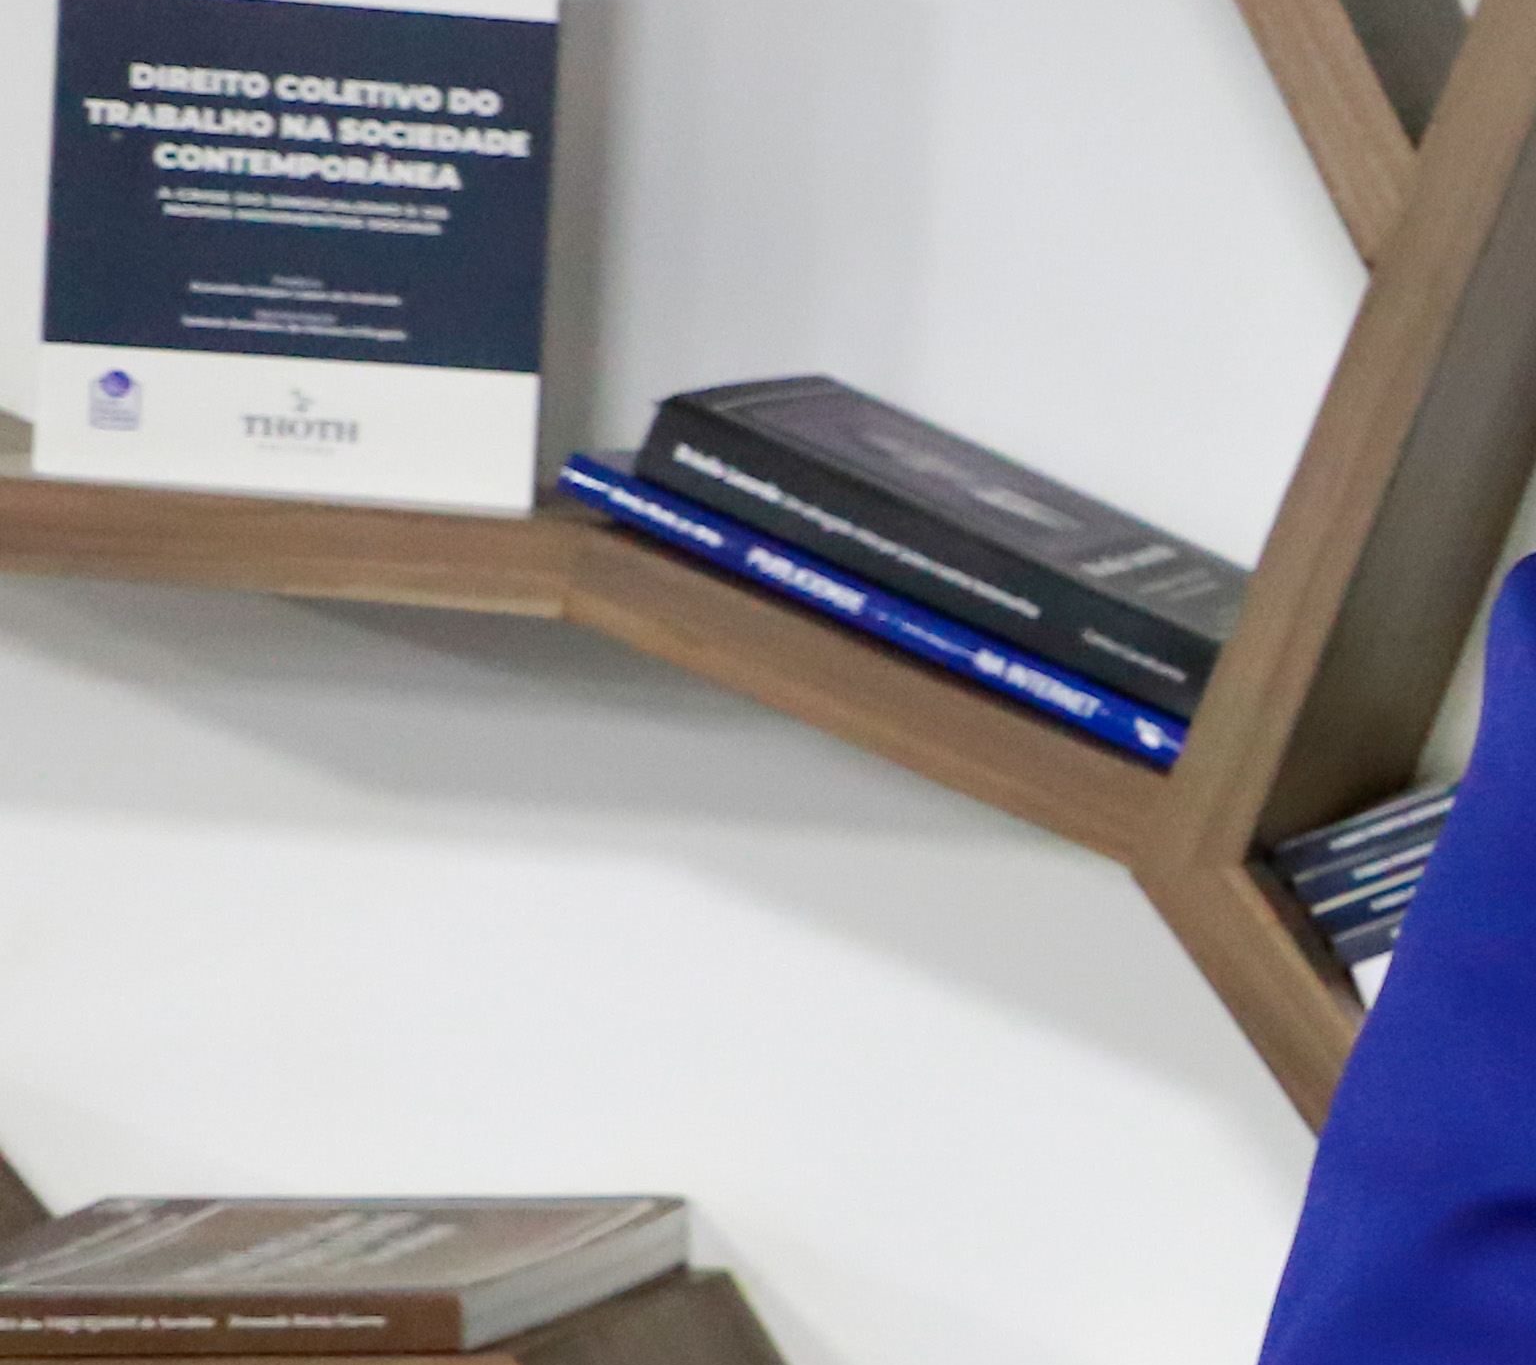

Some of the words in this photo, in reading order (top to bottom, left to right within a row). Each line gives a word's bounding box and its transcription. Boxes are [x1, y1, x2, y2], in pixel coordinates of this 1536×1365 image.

[128, 62, 270, 99] DIREITO
[273, 74, 443, 113] COLETIVO
[446, 87, 502, 117] DO
[83, 97, 274, 138] TRABALHO
[278, 113, 333, 143] NA
[336, 116, 531, 158] SOCIEDADE
[152, 141, 462, 191] CONTEMPORÂNEA
[242, 412, 359, 446] THOTH
